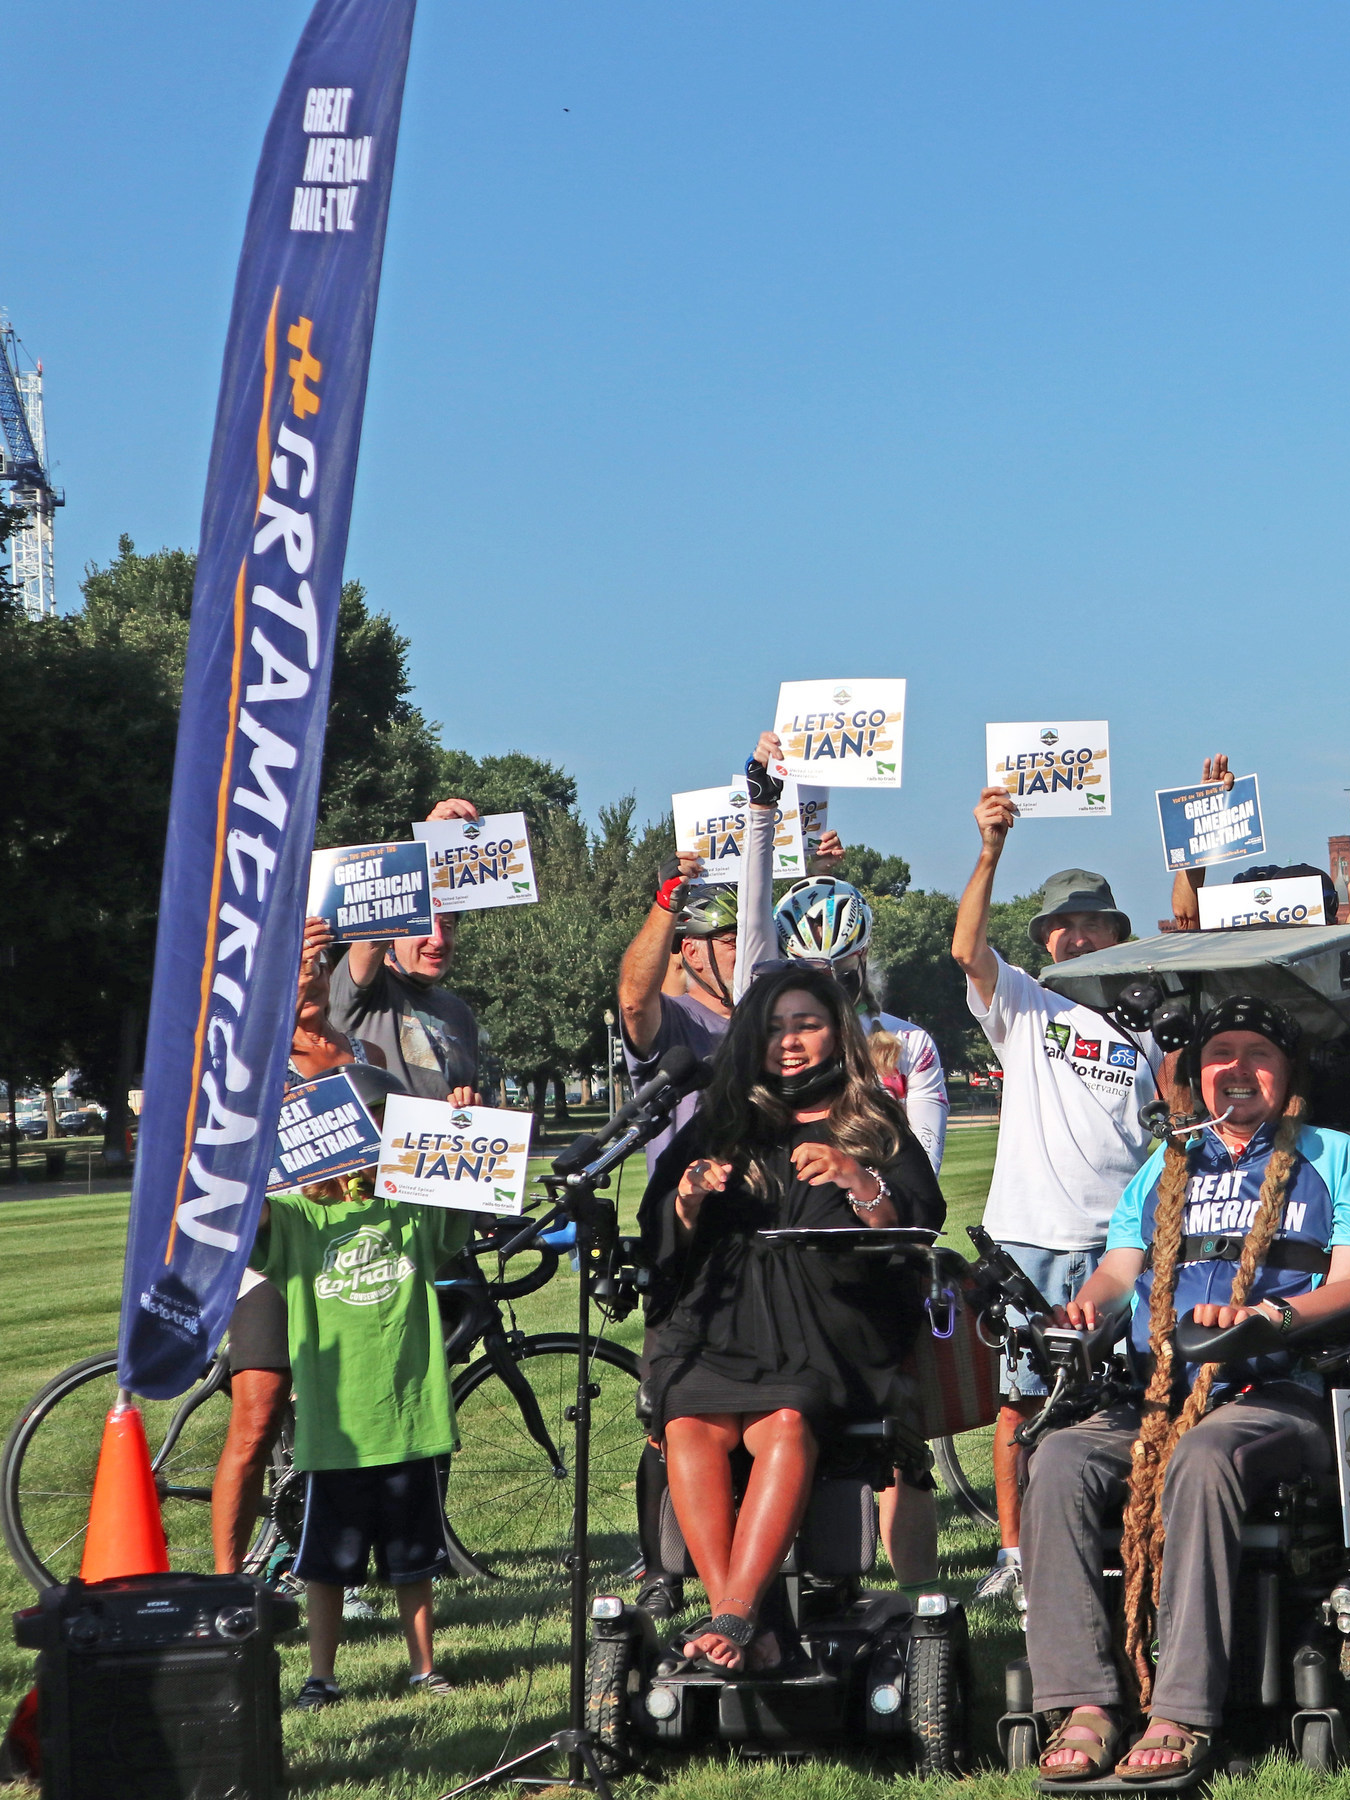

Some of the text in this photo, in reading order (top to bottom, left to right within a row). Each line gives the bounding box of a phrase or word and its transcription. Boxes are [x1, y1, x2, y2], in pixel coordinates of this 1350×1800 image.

[303, 88, 353, 133] GREAT
[792, 709, 886, 732] LET'S GO
[804, 729, 876, 760] IAN!
[1005, 748, 1093, 771] LET'S GO
[1018, 766, 1085, 796] IAN!
[1184, 793, 1224, 820] GREAT
[1193, 799, 1255, 836] AMERICAN
[695, 813, 745, 836] LET'S
[1189, 819, 1252, 855] RAIL-TRAIL
[435, 839, 513, 867] LET'S GO
[334, 857, 383, 885] GREAT
[449, 856, 508, 890] IAN!
[344, 871, 422, 905] AMERICAN
[337, 894, 417, 928] RAIL-TRAIL
[1276, 904, 1308, 924] GO
[278, 1102, 361, 1151] AMERICAN
[279, 1124, 366, 1173] RAIL-TRAIL
[404, 1132, 509, 1155] LET'S GO
[414, 1152, 496, 1183] IAN!
[1187, 1170, 1249, 1203] REAT
